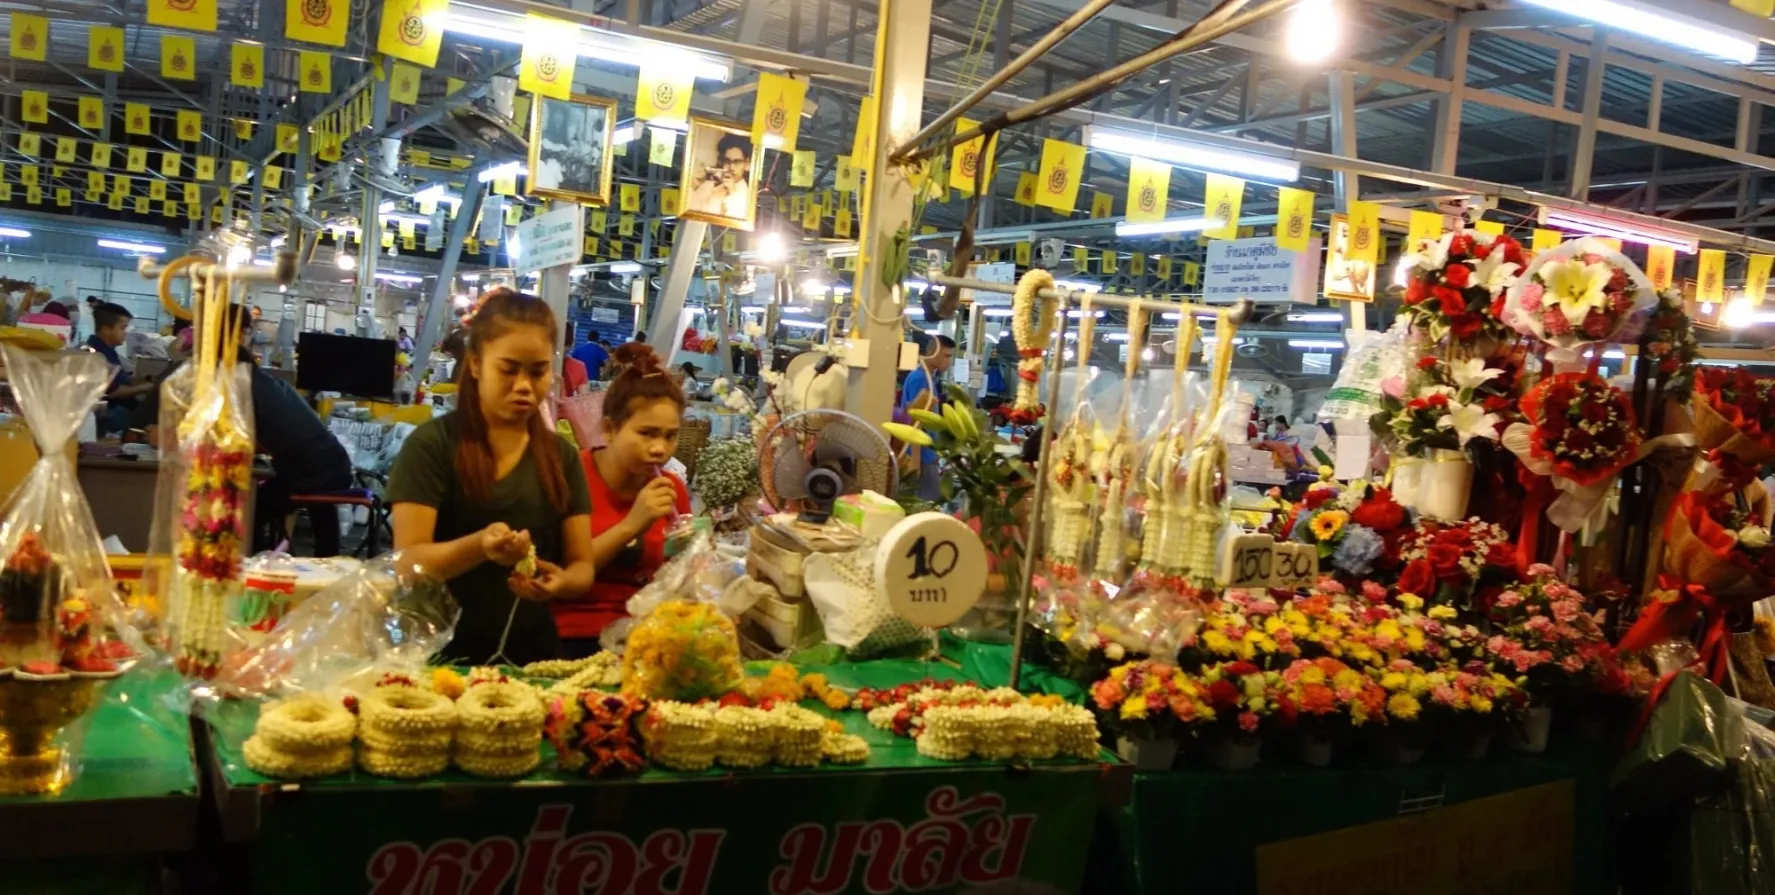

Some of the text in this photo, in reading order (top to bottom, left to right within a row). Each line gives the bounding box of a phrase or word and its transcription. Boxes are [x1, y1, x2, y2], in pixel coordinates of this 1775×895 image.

[905, 535, 959, 580] 10
[1235, 547, 1272, 583] 150
[768, 784, 1038, 895] มาลัย
